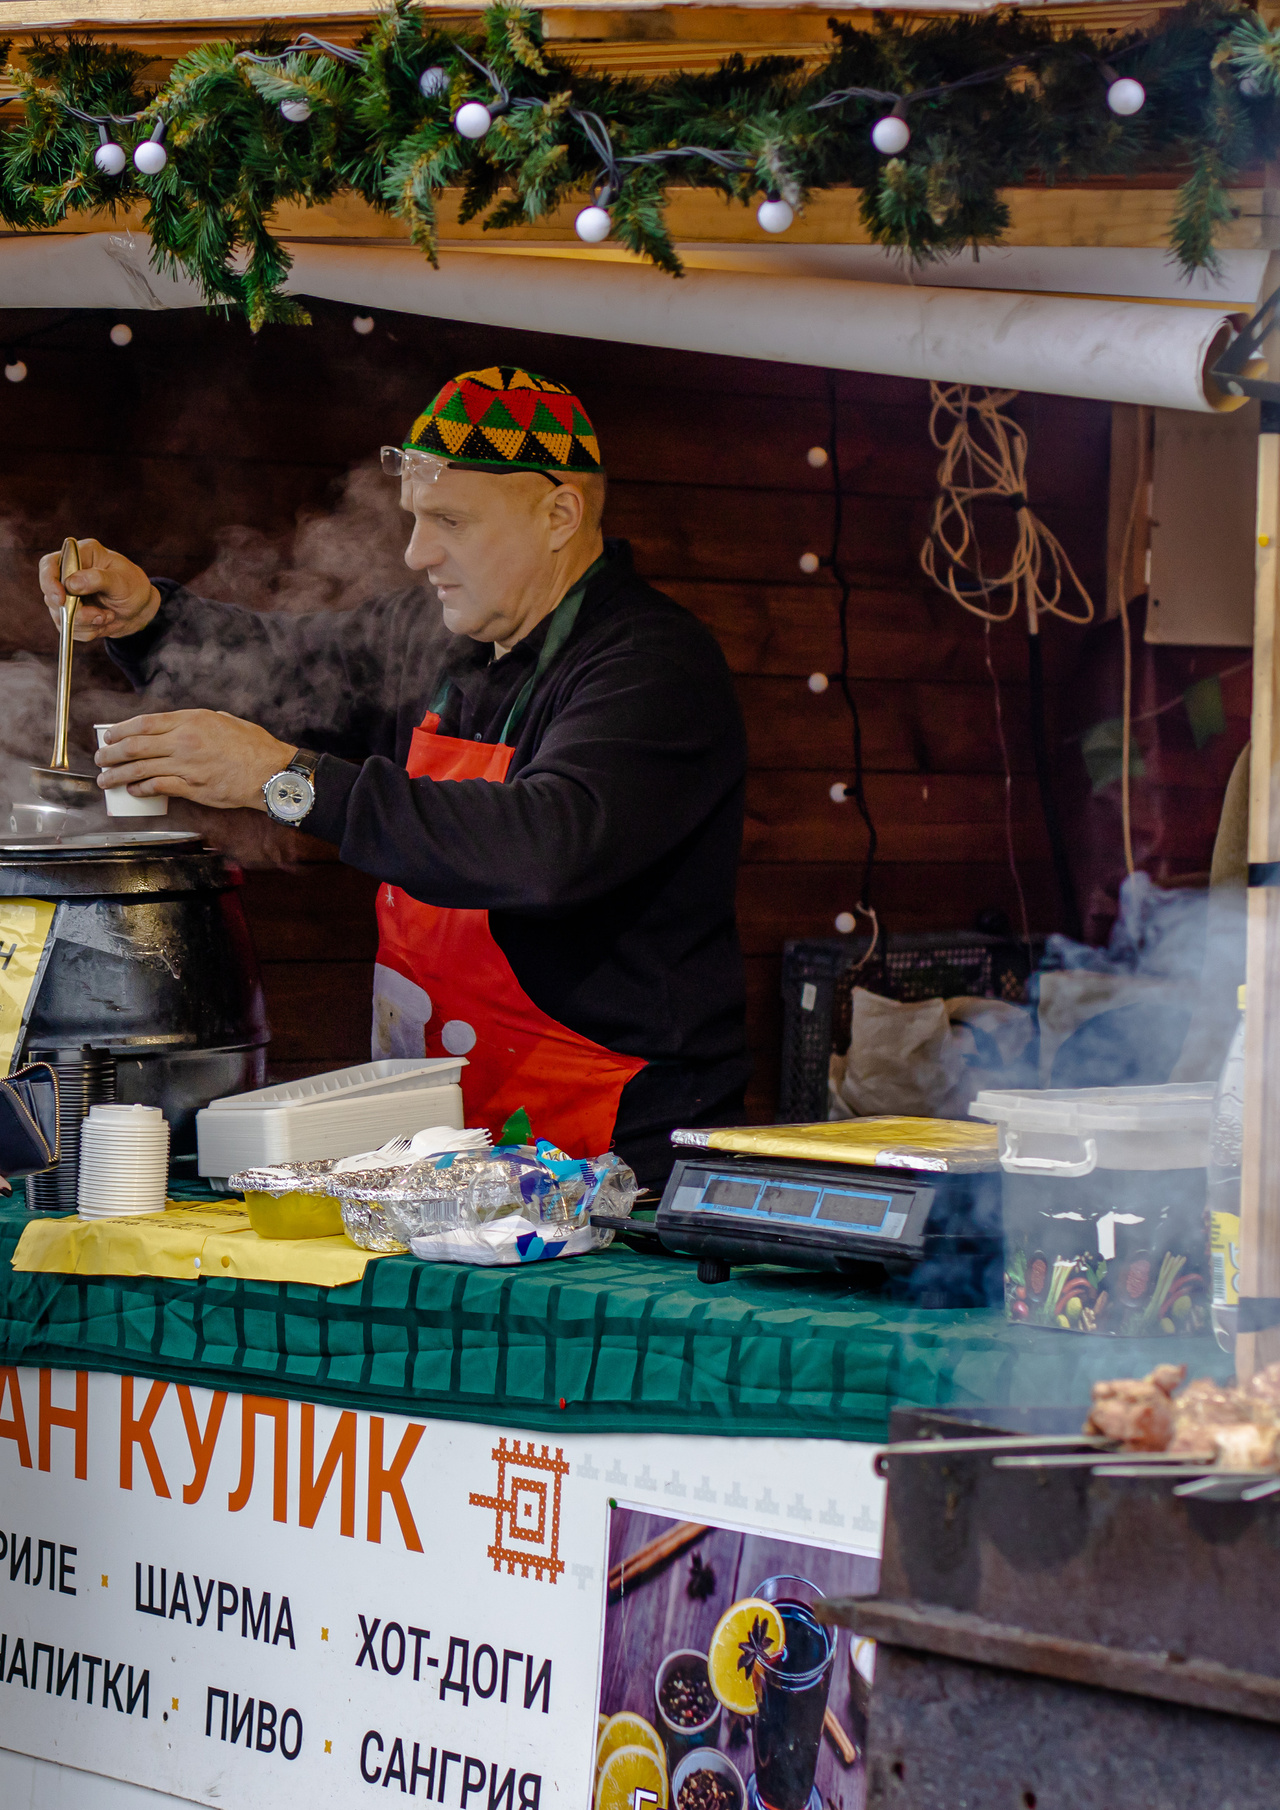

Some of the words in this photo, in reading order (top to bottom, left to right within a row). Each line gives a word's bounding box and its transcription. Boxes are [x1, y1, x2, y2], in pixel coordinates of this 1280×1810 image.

[120, 1375, 427, 1554] КУЛИК
[135, 1561, 297, 1651] ШАУРМА
[355, 1614, 553, 1714] ХОТ-ДОГИ
[204, 1686, 303, 1761] ПИВО
[359, 1729, 543, 1810] САНГРИЯ
